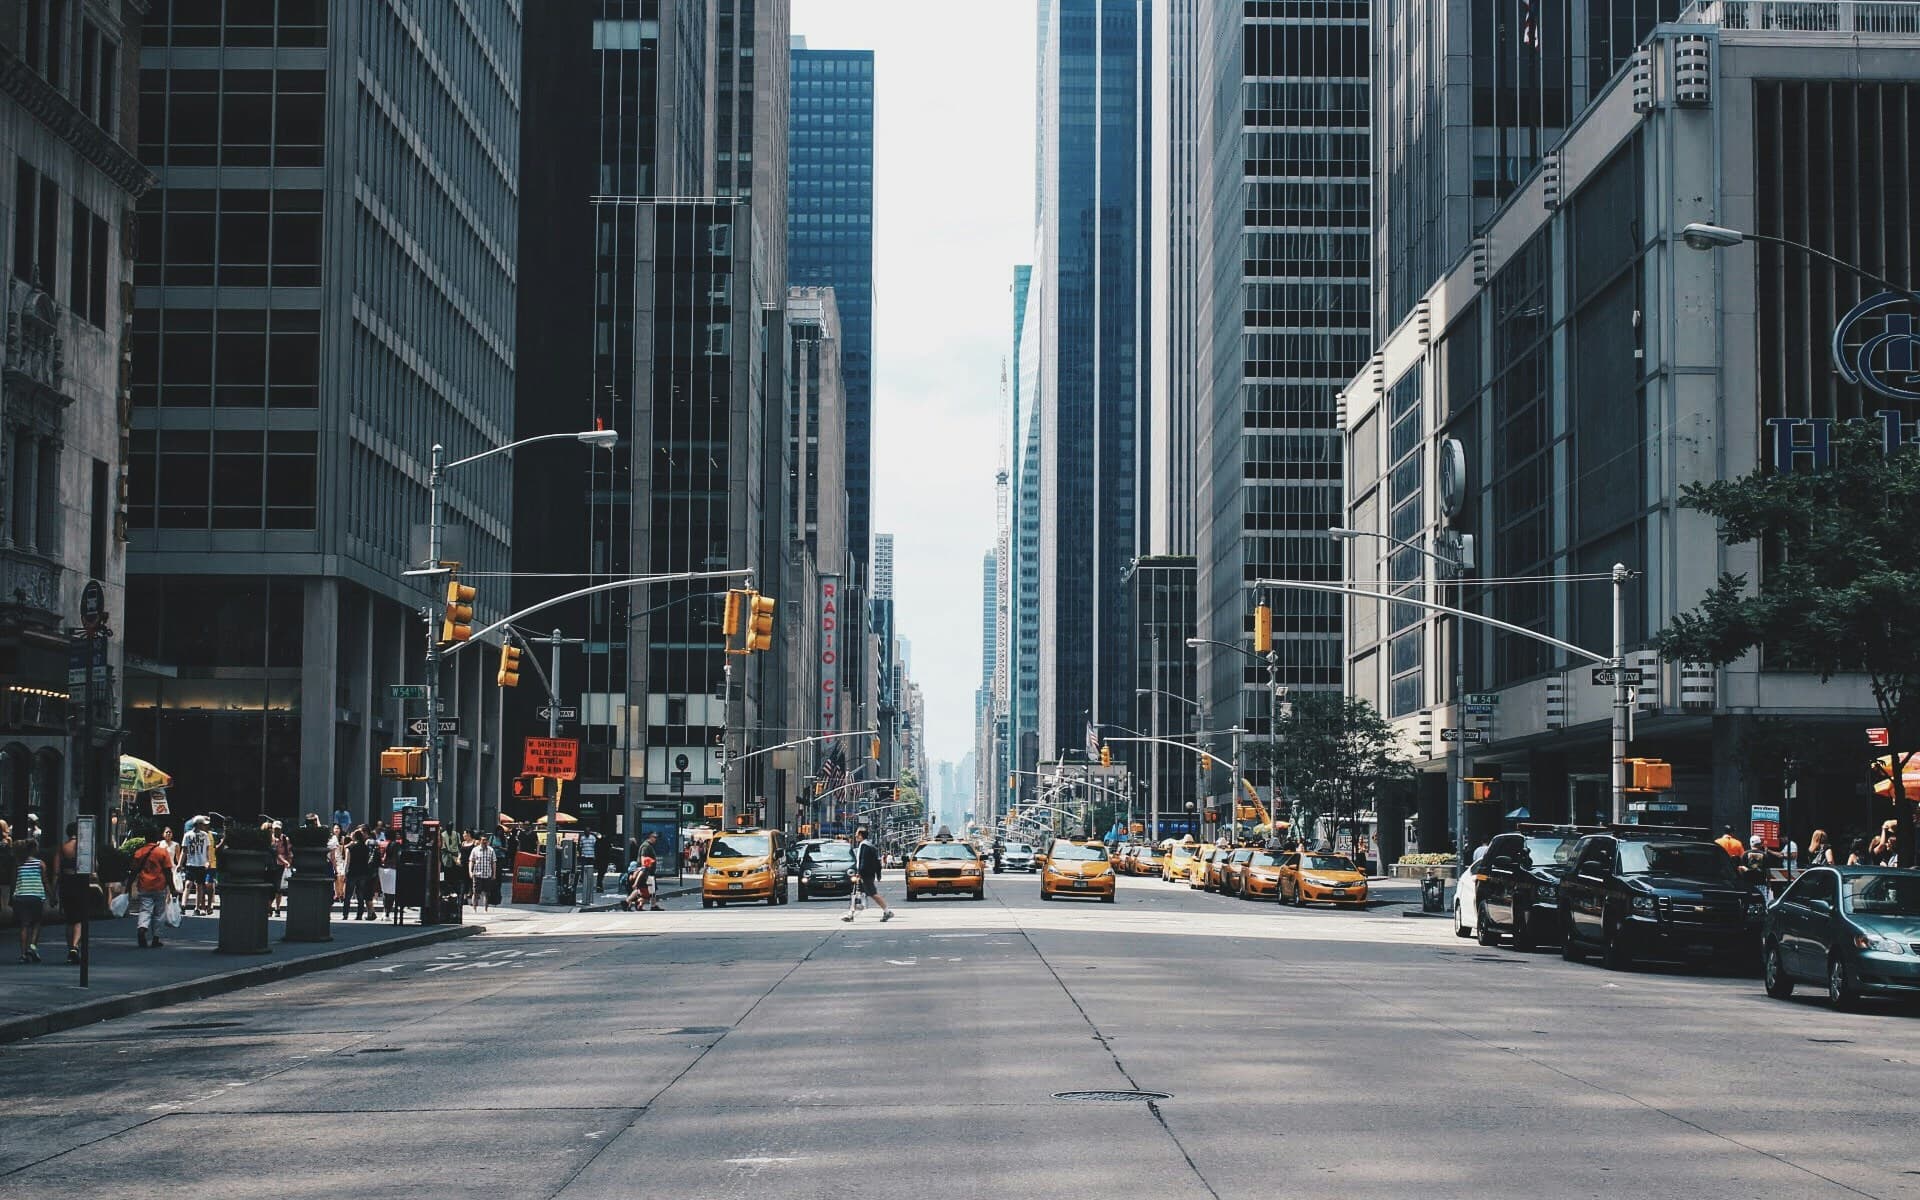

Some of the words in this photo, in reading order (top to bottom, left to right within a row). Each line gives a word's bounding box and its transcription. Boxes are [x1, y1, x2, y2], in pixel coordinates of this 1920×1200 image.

[822, 583, 836, 664] RADIO
[392, 688, 398, 696] W
[400, 688, 410, 696] 54
[1481, 696, 1490, 704] 54
[822, 679, 835, 743] CITY
